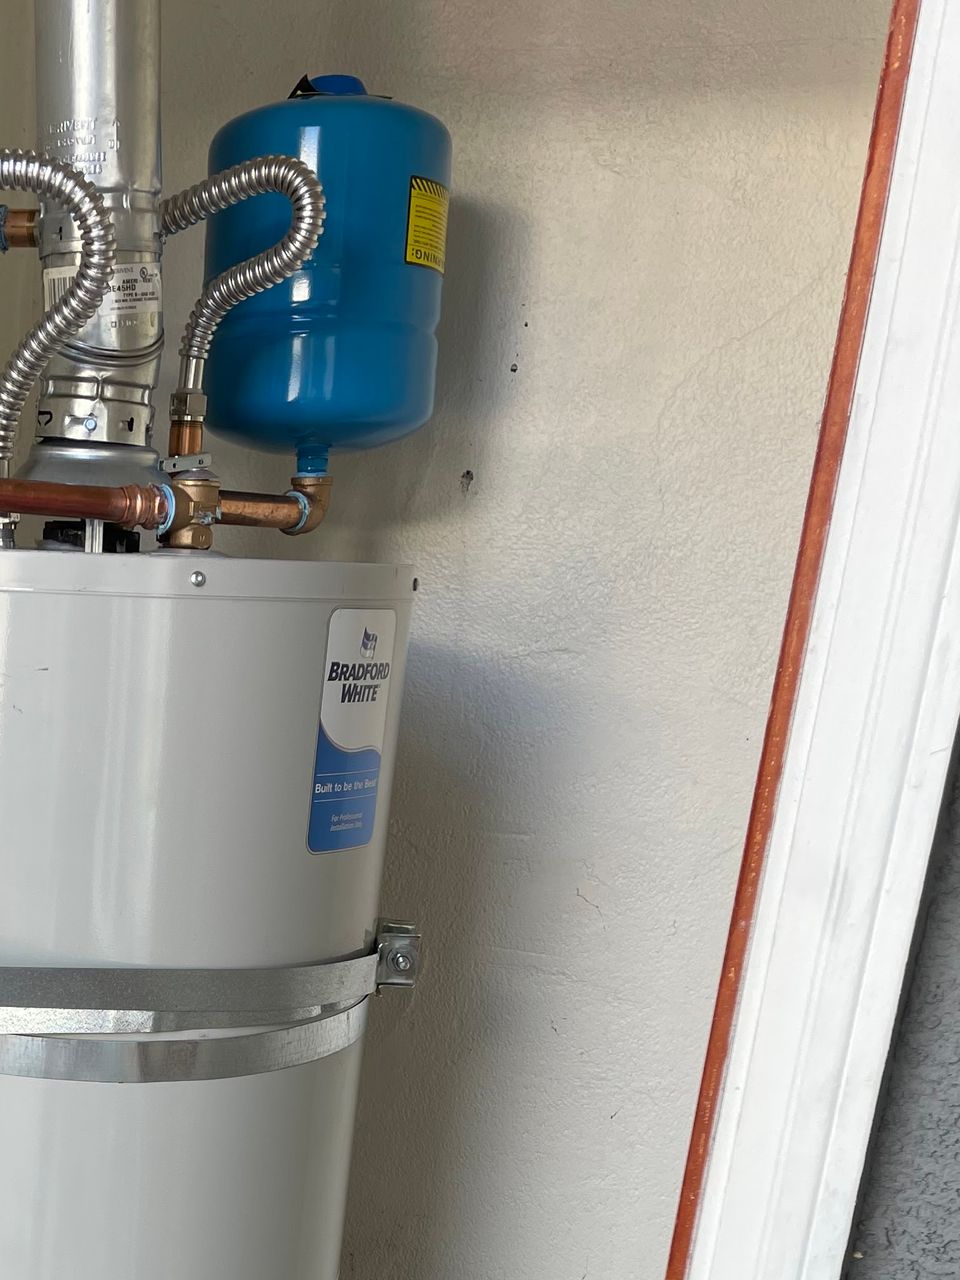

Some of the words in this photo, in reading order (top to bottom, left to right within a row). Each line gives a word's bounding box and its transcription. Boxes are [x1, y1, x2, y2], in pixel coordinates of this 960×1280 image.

[328, 662, 390, 681] BRADFORD
[341, 683, 378, 703] WHITE
[315, 783, 332, 793] Built
[335, 783, 341, 791] to
[344, 782, 352, 790] be
[354, 781, 363, 790] the
